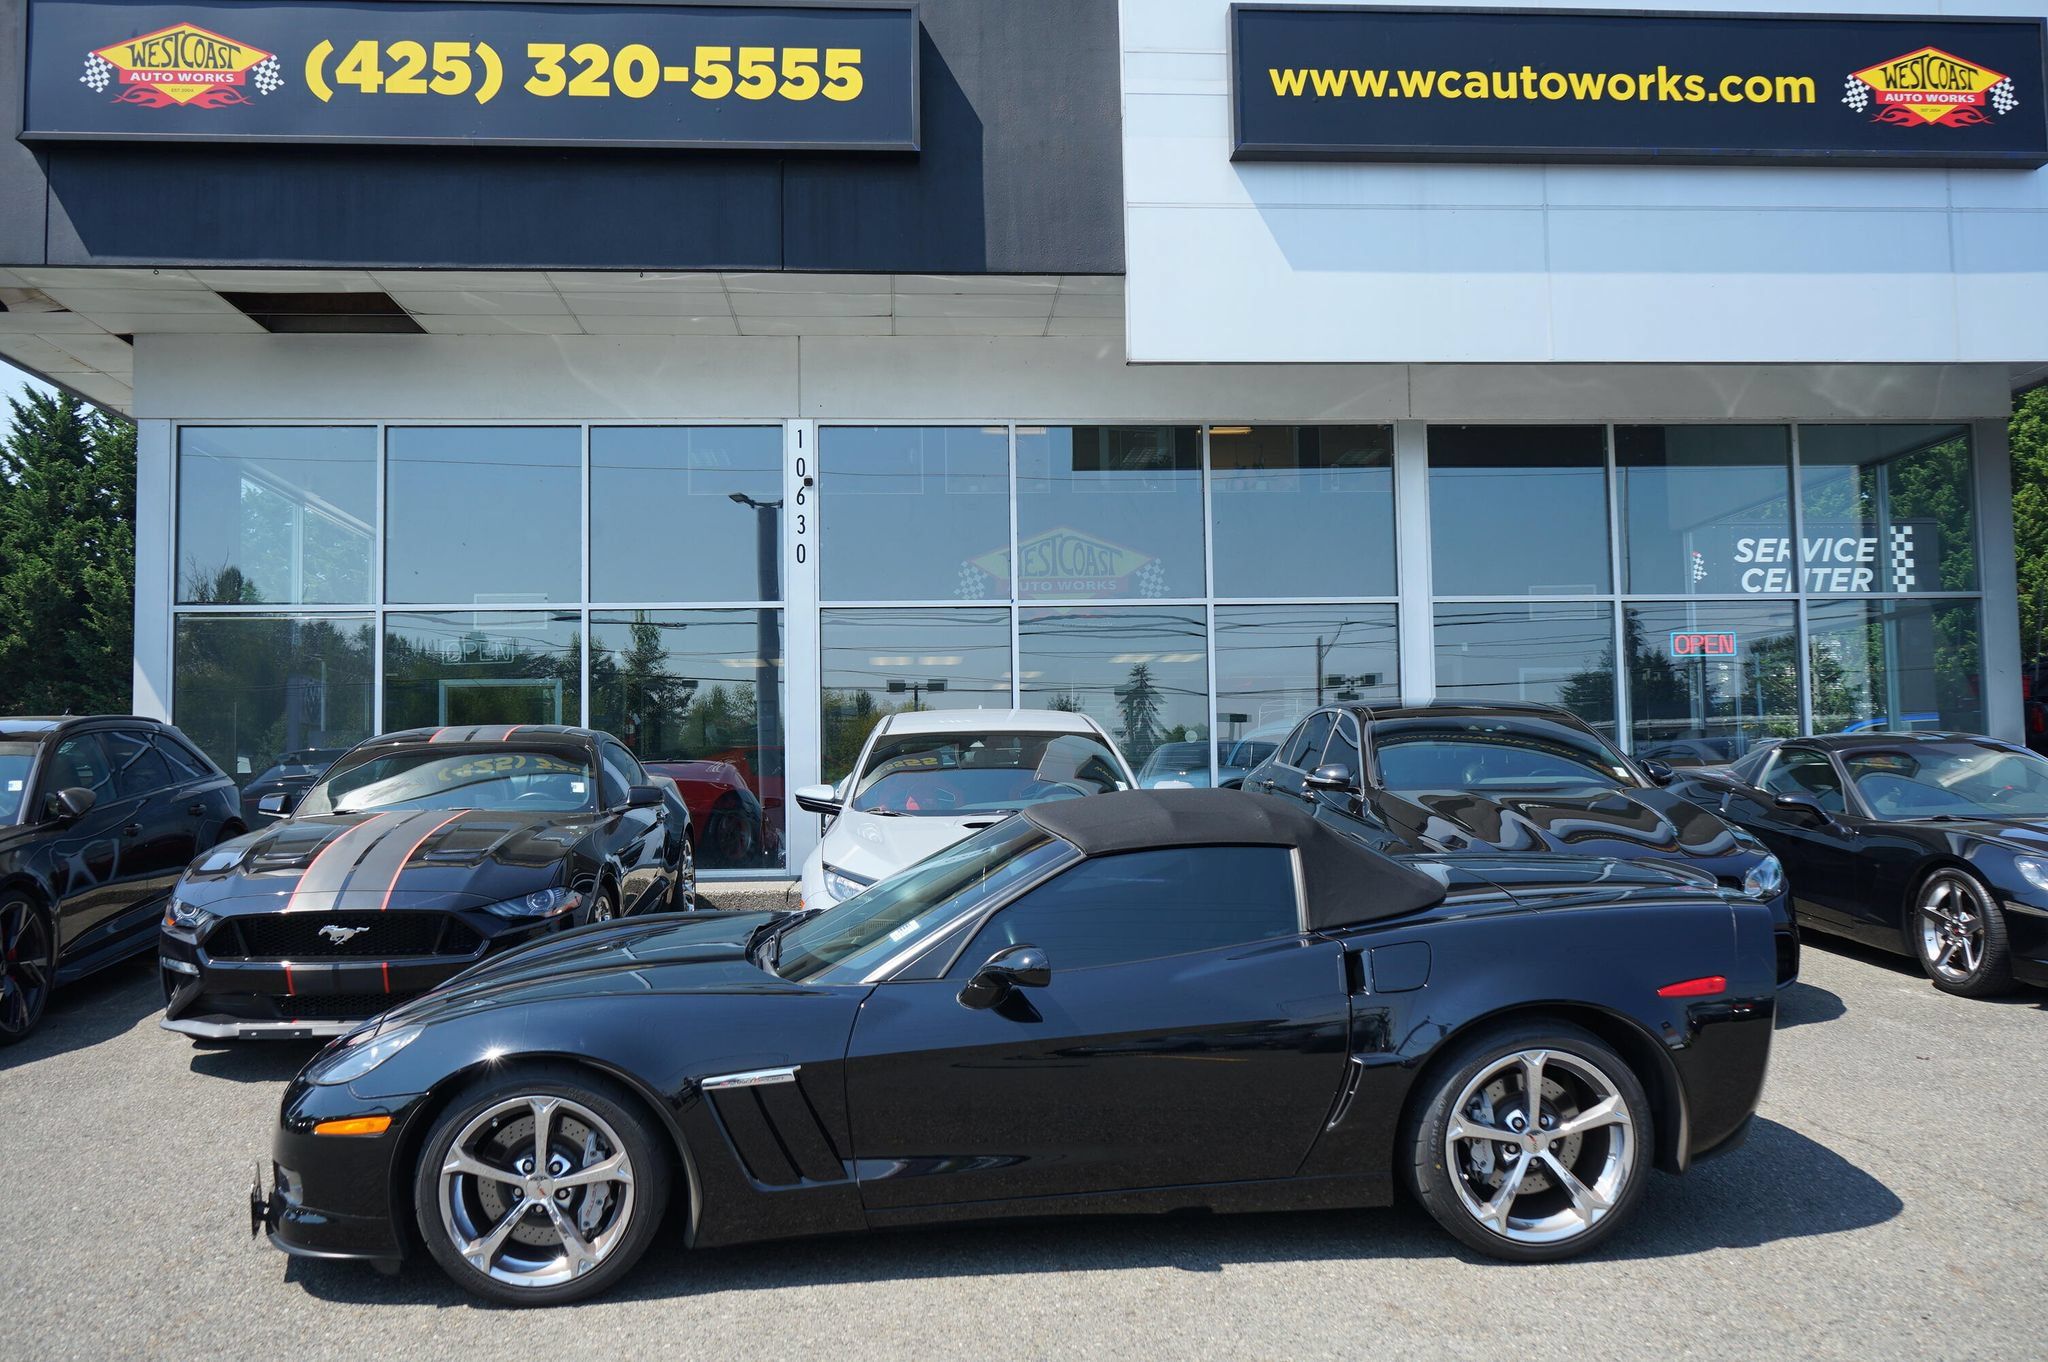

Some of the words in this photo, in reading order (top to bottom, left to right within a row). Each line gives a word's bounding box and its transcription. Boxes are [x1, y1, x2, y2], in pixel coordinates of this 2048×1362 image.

[130, 72, 174, 82] AUTO
[178, 73, 235, 83] WORKS
[305, 38, 504, 105] (425)
[523, 43, 864, 102] 320-5555
[1269, 65, 1816, 104] www.wcautoworks.com
[1885, 93, 1923, 102] AUTO
[1925, 93, 1976, 103] WORKS
[796, 429, 806, 564] 10630
[1017, 581, 1050, 592] UTO
[1061, 580, 1117, 591] WORKS
[1674, 634, 1734, 655] OPEN
